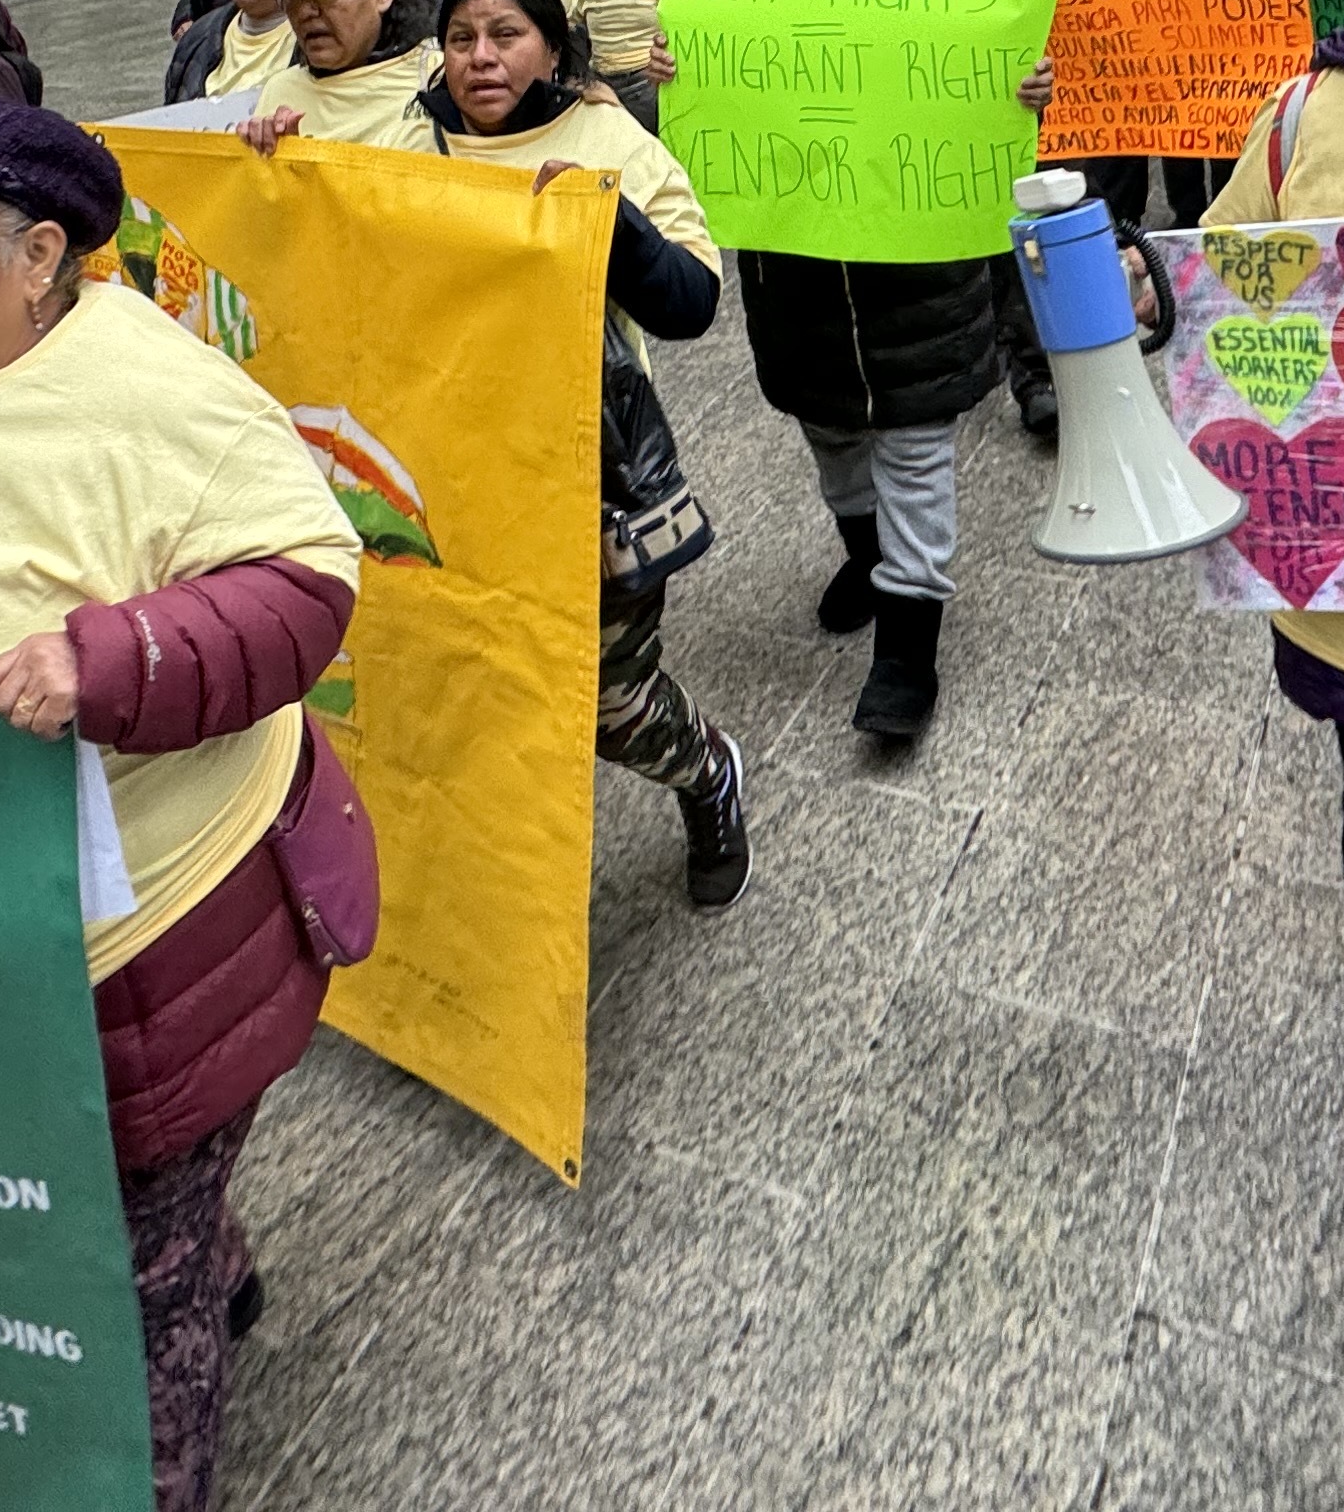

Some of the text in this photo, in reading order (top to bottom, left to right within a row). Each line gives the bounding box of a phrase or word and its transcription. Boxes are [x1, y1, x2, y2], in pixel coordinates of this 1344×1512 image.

[1160, 23, 1299, 53] SOLAMENTE
[673, 27, 874, 94] MMIGRANT
[1253, 53, 1307, 79] PARA
[1130, 85, 1138, 100] Y
[1146, 83, 1176, 103] EL
[1102, 105, 1116, 125] O
[1114, 127, 1211, 151] ADULTOS
[657, 128, 858, 206] VENDOR
[162, 239, 198, 270] HOT
[1202, 232, 1313, 265] RESPECT
[161, 254, 200, 291] DOG
[1220, 259, 1275, 285] FOR
[1241, 283, 1275, 311] US
[1211, 325, 1329, 356] ESSENTIAL
[1215, 354, 1319, 384] WORKERS
[1247, 385, 1292, 408] 100%
[1197, 438, 1343, 488] MORE
[1274, 563, 1314, 596] US
